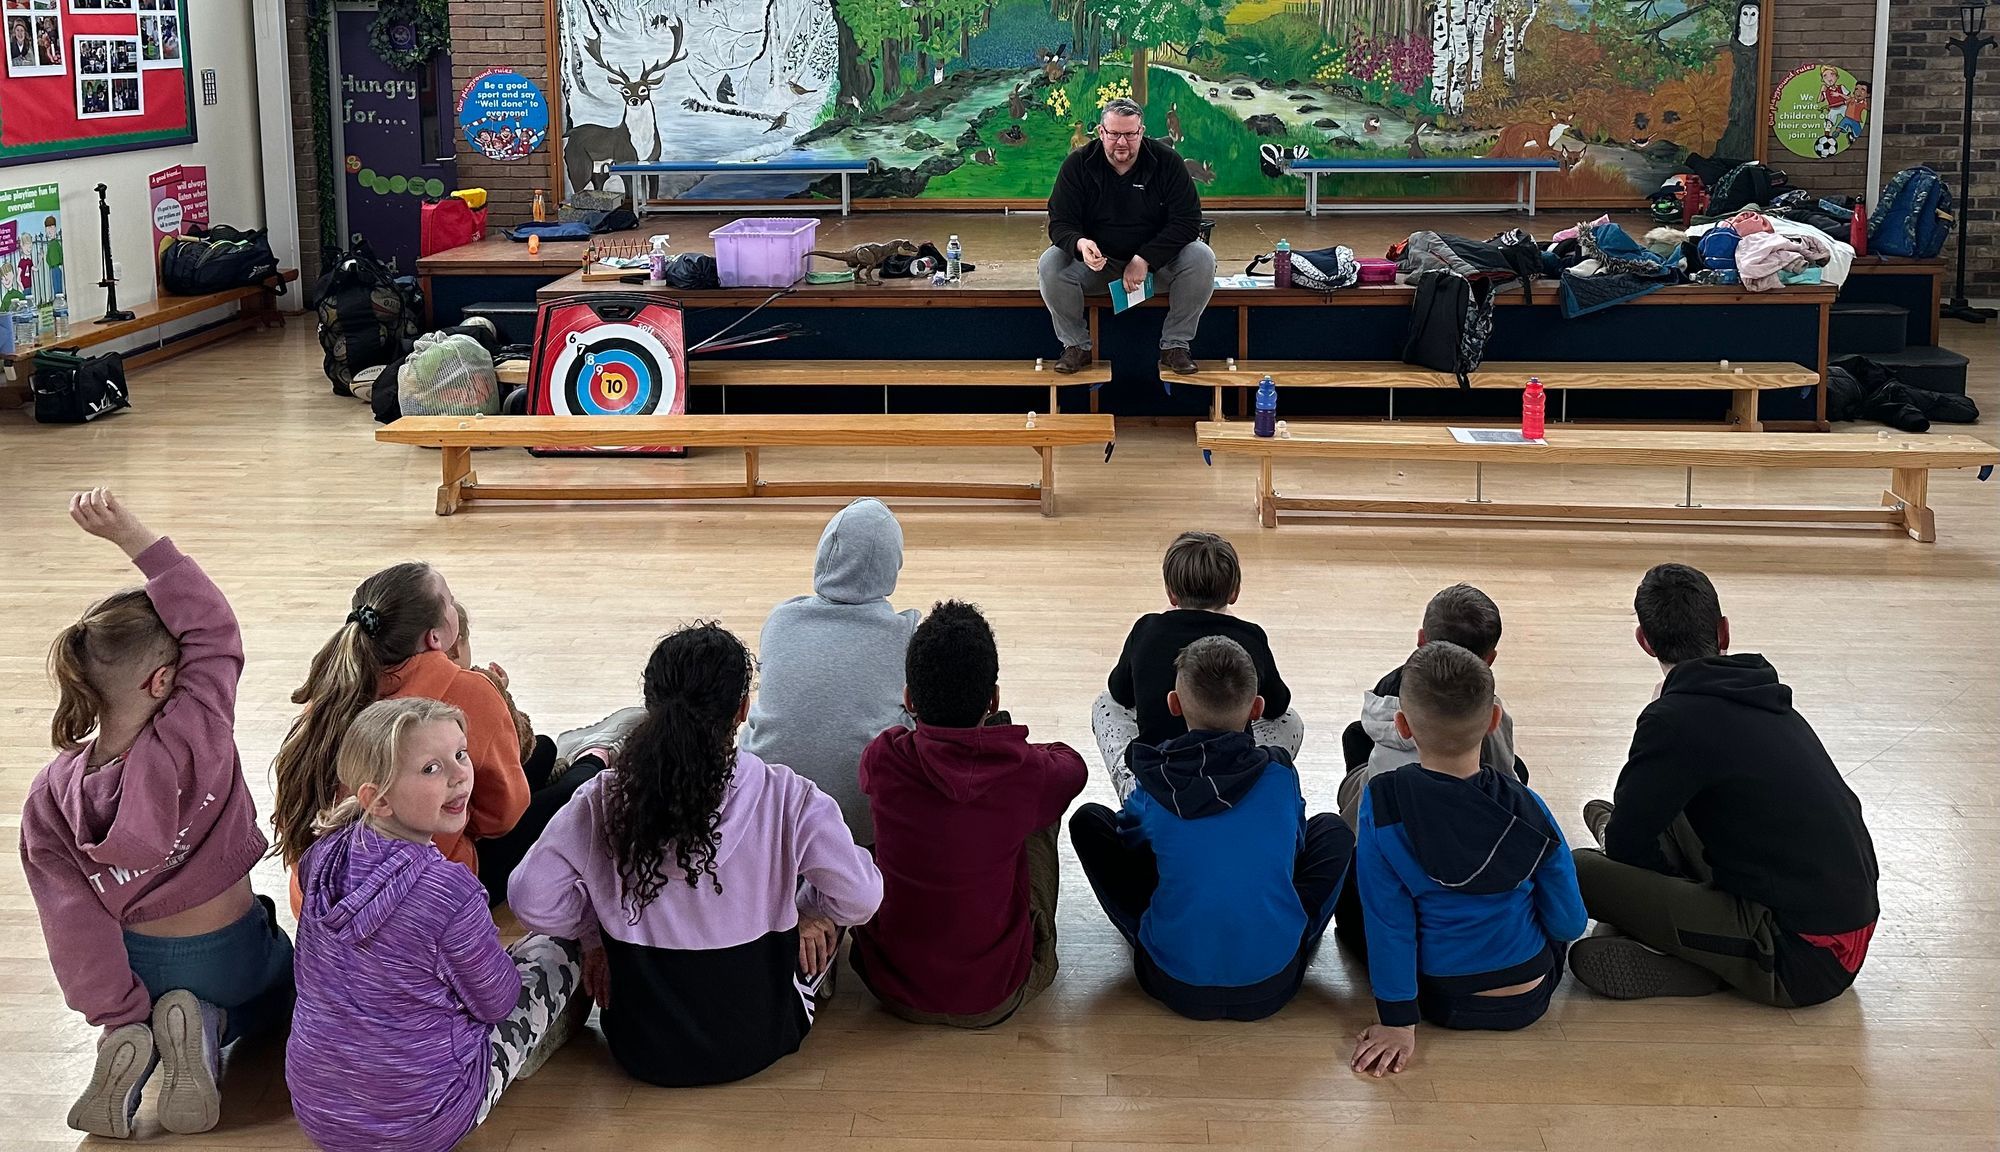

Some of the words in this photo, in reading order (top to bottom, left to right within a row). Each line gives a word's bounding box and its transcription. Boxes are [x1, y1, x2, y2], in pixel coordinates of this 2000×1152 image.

[341, 74, 416, 99] Hungry
[506, 82, 528, 90] good
[477, 92, 499, 100] sport
[520, 92, 536, 100] say
[1800, 93, 1814, 101] We
[1793, 102, 1819, 110] invite
[486, 109, 528, 118] everyone!
[1779, 112, 1817, 120] children
[1778, 121, 1798, 129] their
[1788, 132, 1806, 140] join
[156, 173, 166, 184] good
[177, 181, 187, 190] will
[188, 180, 206, 189] always
[13, 189, 38, 201] playtime
[38, 187, 48, 196] fun
[48, 185, 57, 194] for
[177, 192, 192, 201] listen
[193, 190, 207, 199] when
[8, 199, 35, 212] everyone!
[183, 204, 193, 213] you
[198, 208, 208, 218] talk
[568, 333, 577, 344] 6
[577, 344, 586, 356] 7
[587, 355, 595, 365] 8
[595, 365, 604, 376] 9
[606, 379, 622, 394] 10
